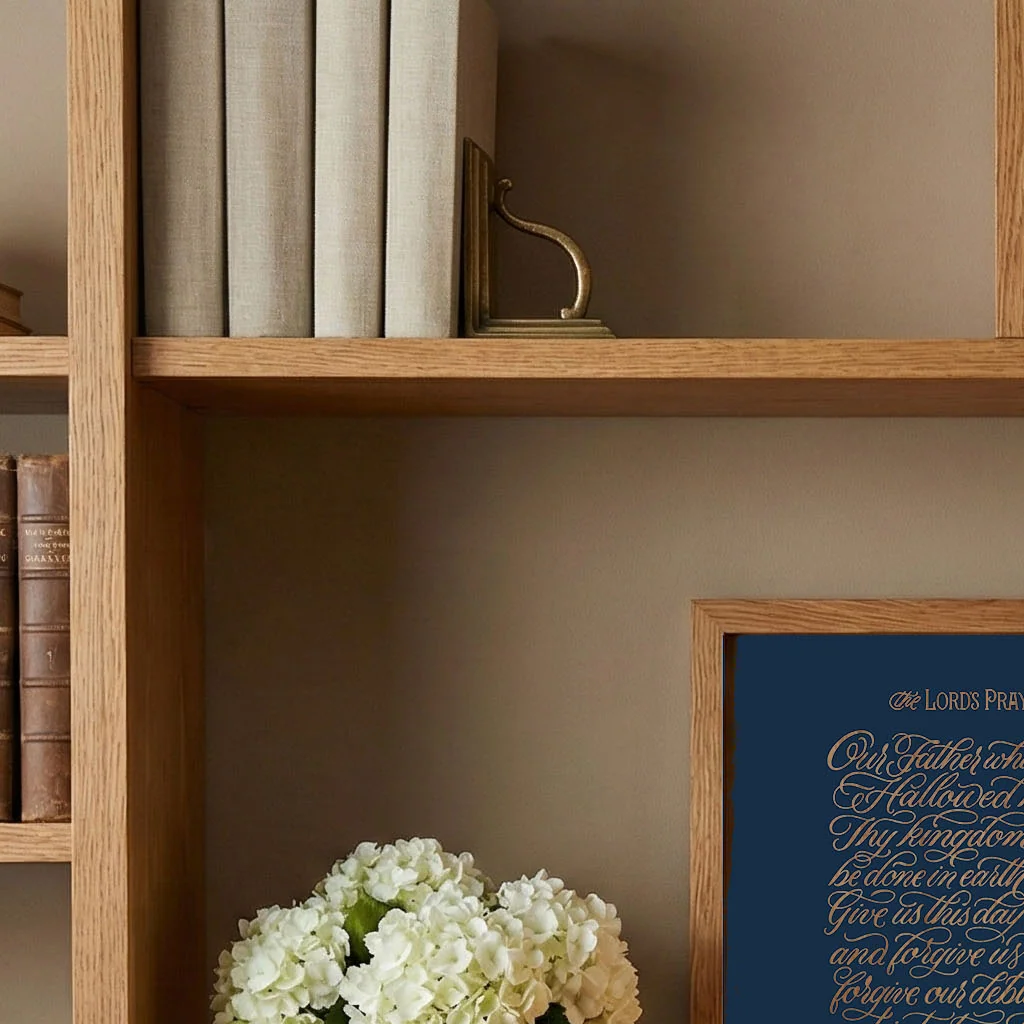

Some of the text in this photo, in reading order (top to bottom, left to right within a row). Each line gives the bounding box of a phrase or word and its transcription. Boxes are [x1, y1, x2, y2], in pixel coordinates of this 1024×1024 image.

[827, 730, 887, 775] Our
[886, 733, 982, 777] Father
[829, 810, 917, 859] Thy
[828, 852, 872, 887] be
[863, 850, 926, 887] done
[926, 866, 957, 889] in
[824, 889, 895, 935] Give
[891, 903, 925, 925] us
[900, 890, 971, 926] this
[829, 932, 889, 965] and
[887, 927, 985, 978] forgive
[829, 966, 920, 1020] forgive
[924, 979, 968, 1008] our
